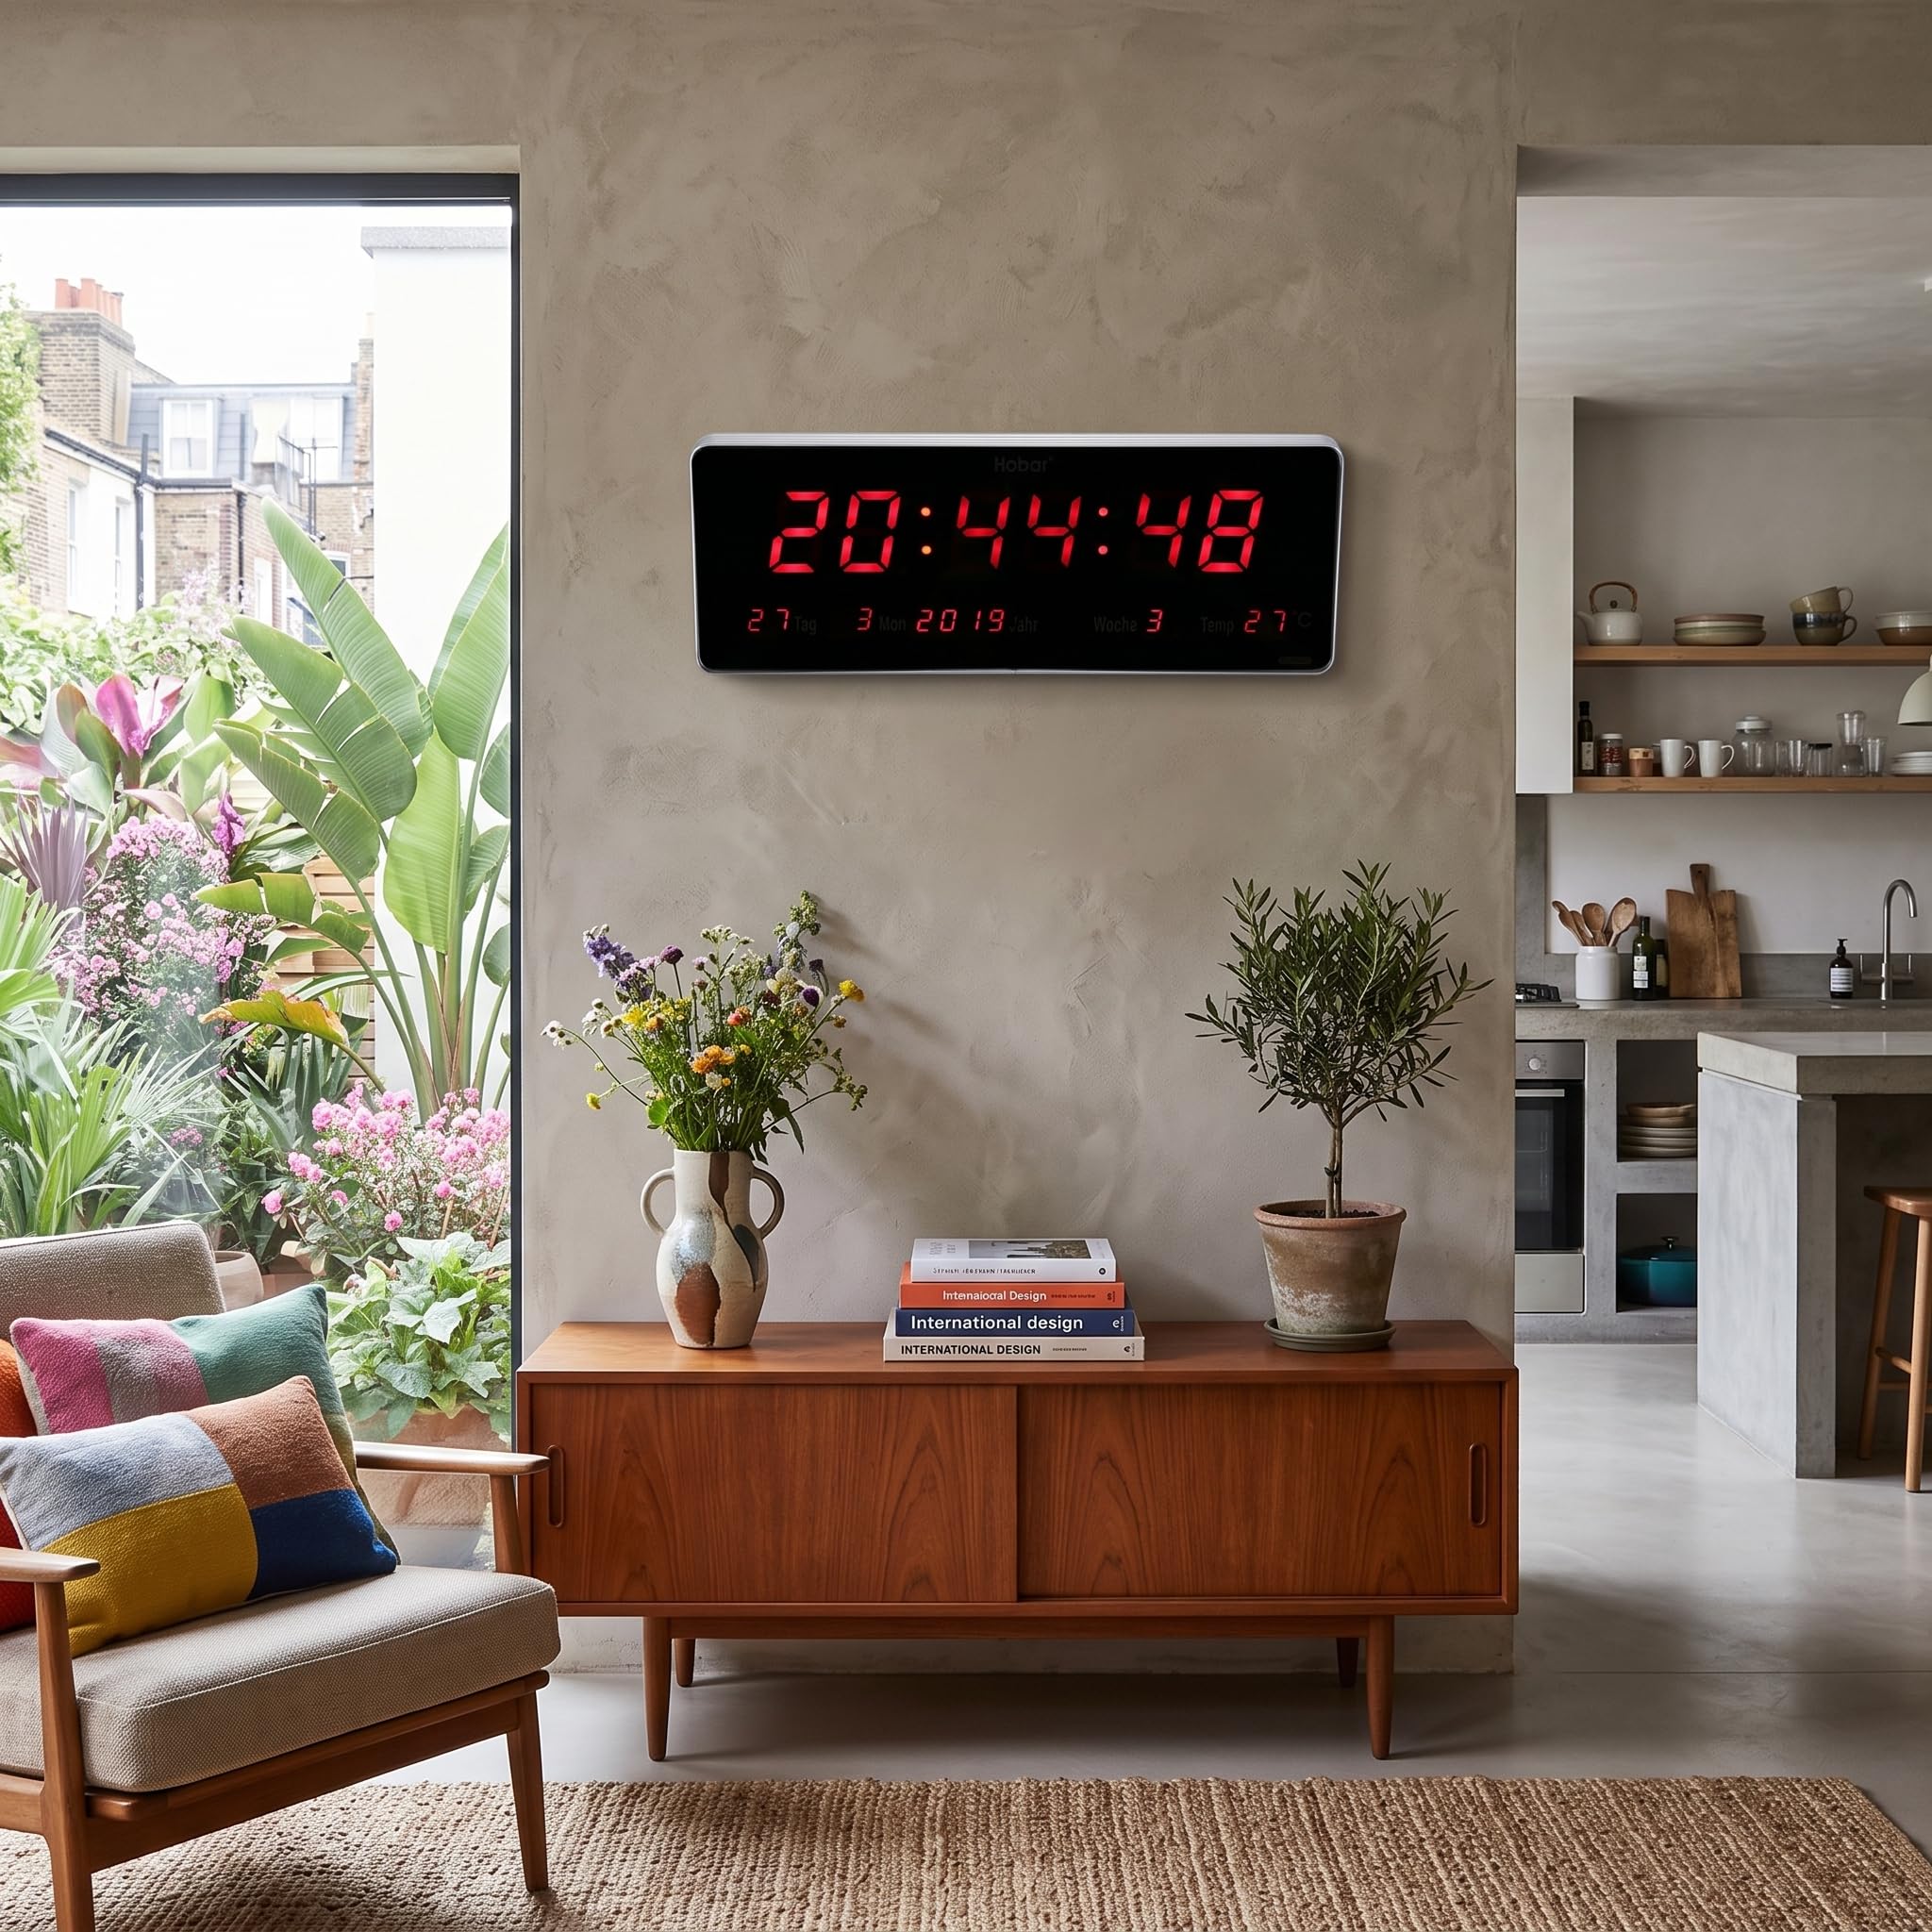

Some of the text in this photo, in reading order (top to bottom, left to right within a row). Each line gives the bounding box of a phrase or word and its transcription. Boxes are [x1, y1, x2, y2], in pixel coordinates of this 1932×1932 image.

[769, 490, 1264, 574] 20:44:48
[855, 608, 874, 631] 3
[878, 615, 906, 633] Mon
[914, 608, 1007, 632] 2019
[1094, 608, 1164, 633] Woche 3
[1009, 1291, 1047, 1302] Design
[911, 1315, 1083, 1333] International design
[901, 1344, 993, 1355] INTERNATIONAL
[996, 1344, 1041, 1355] DESIGN
